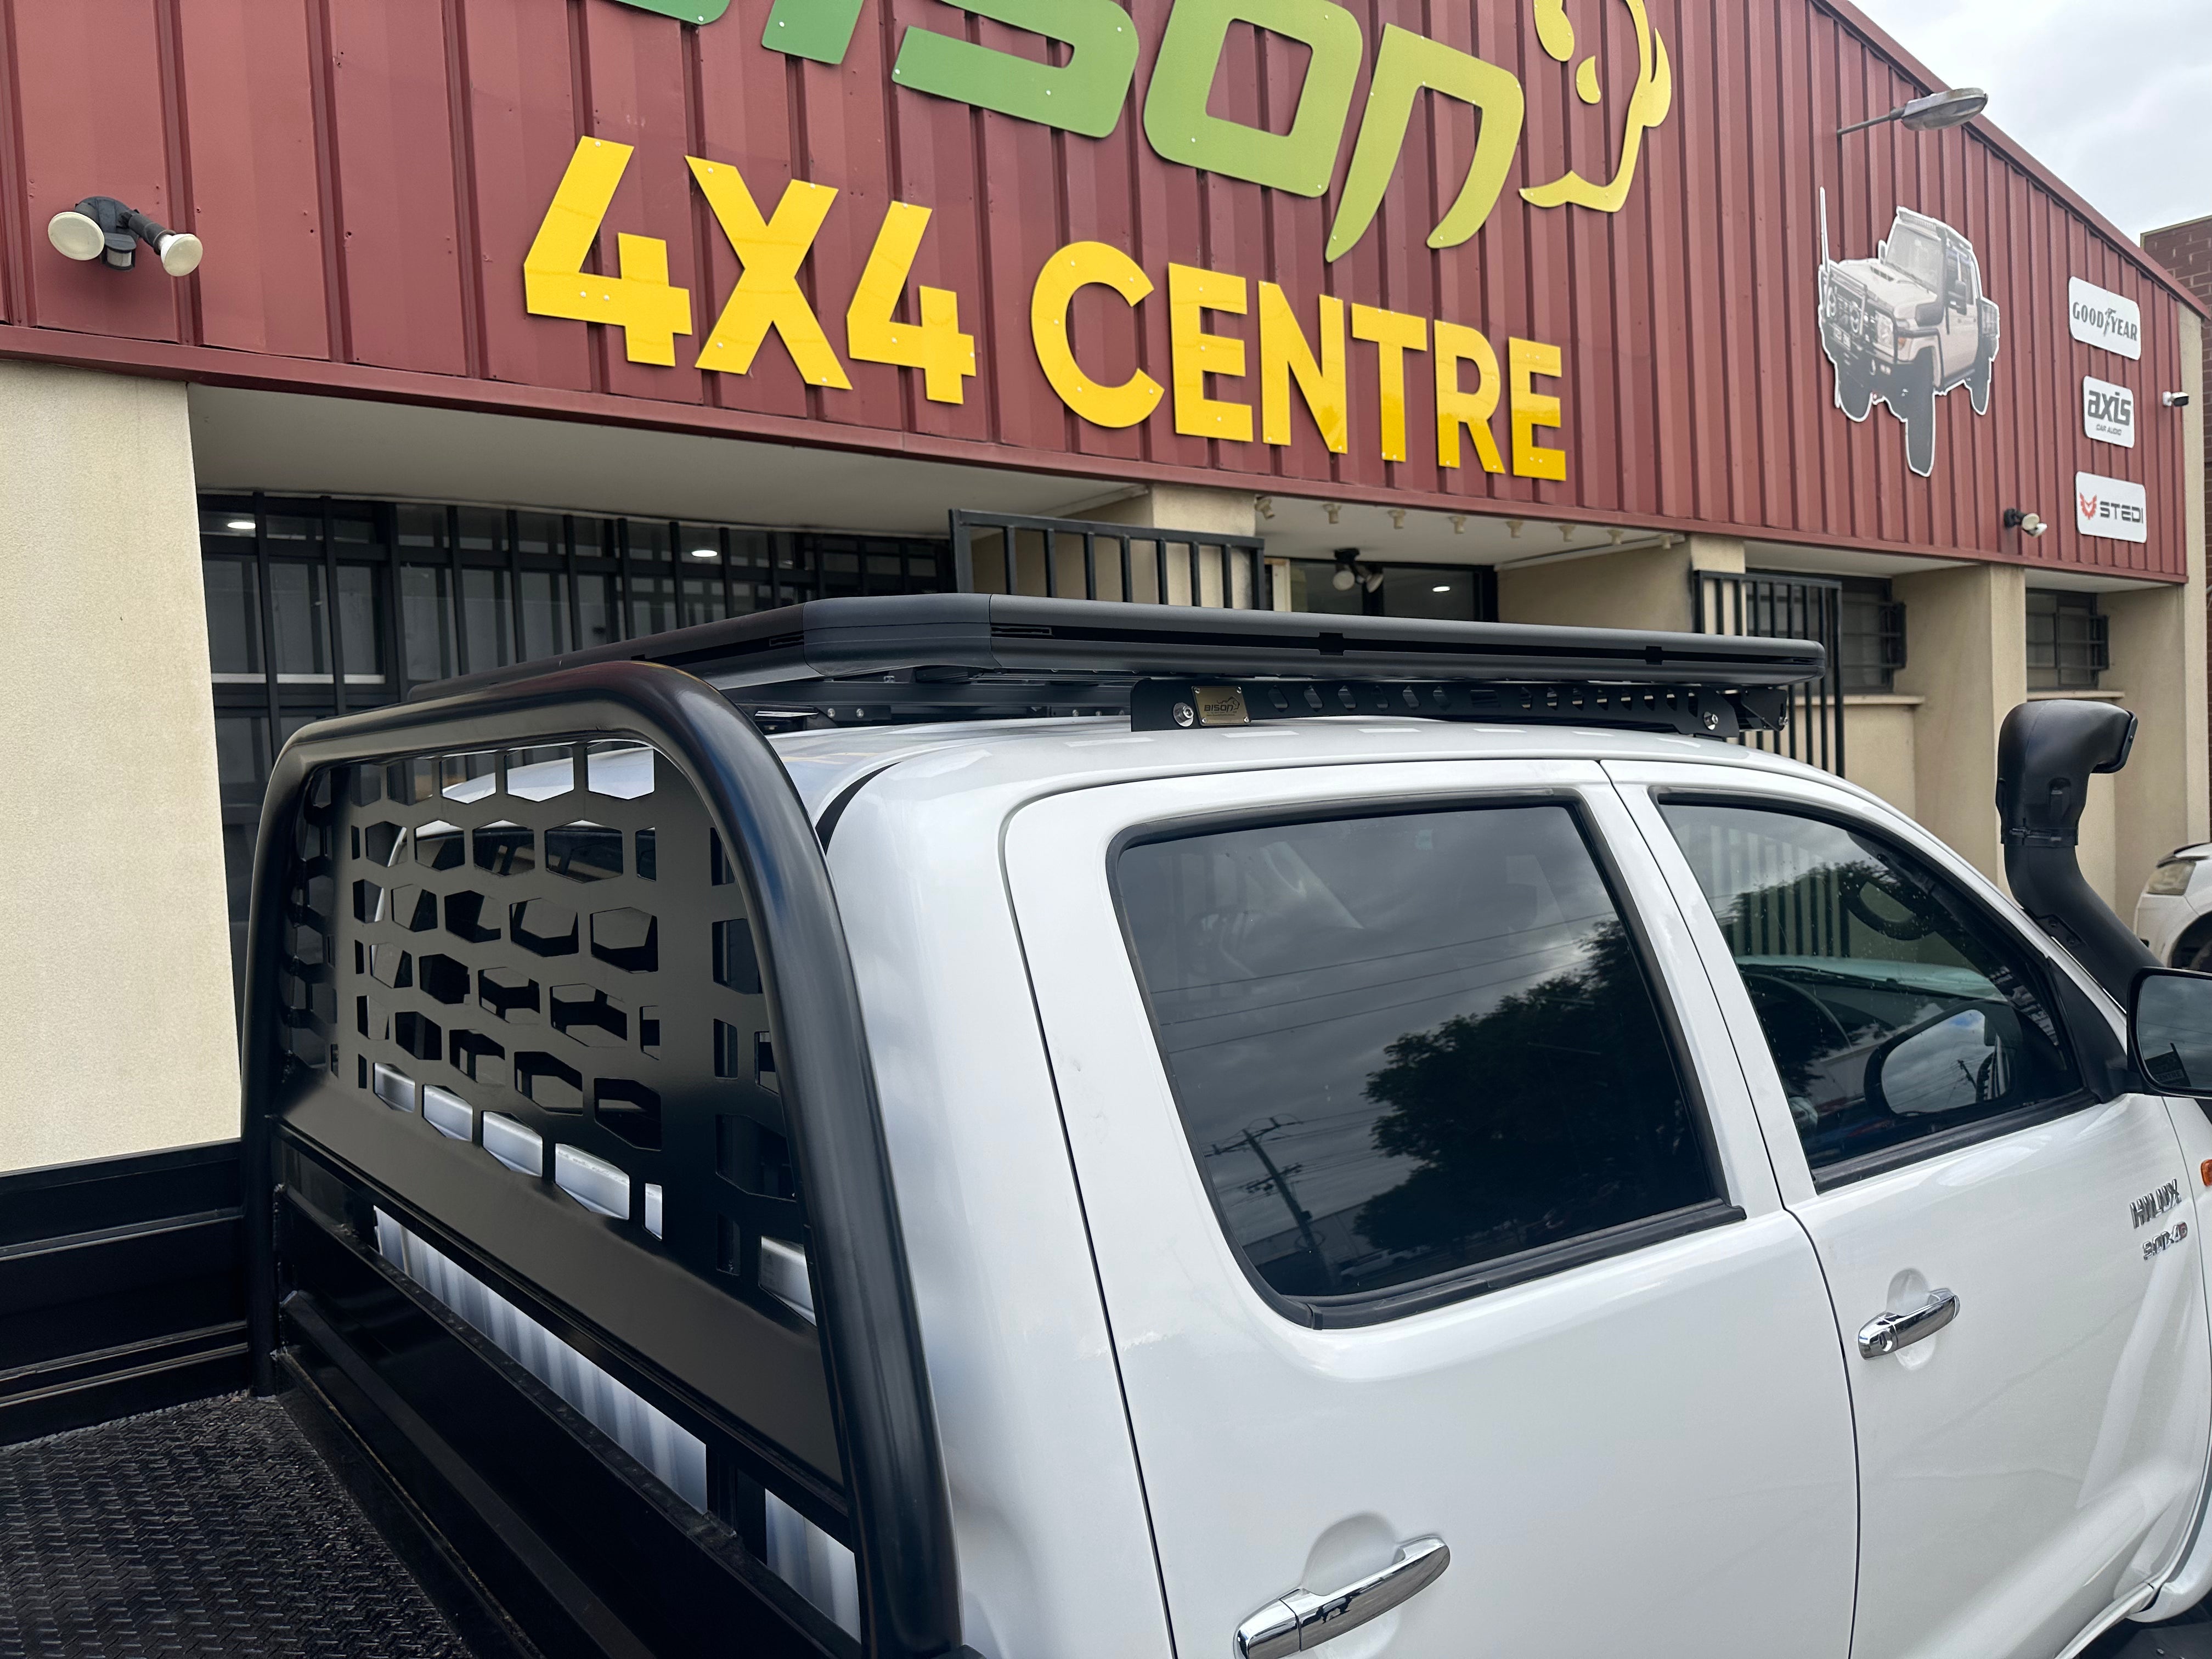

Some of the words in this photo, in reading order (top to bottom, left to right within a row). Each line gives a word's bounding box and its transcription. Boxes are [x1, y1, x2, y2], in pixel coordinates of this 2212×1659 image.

[523, 136, 976, 405] 4X4
[1031, 240, 1567, 481] CENTRE
[2087, 390, 2131, 426] axis
[2100, 501, 2143, 523] STEDI
[2130, 1178, 2181, 1229] HILUX
